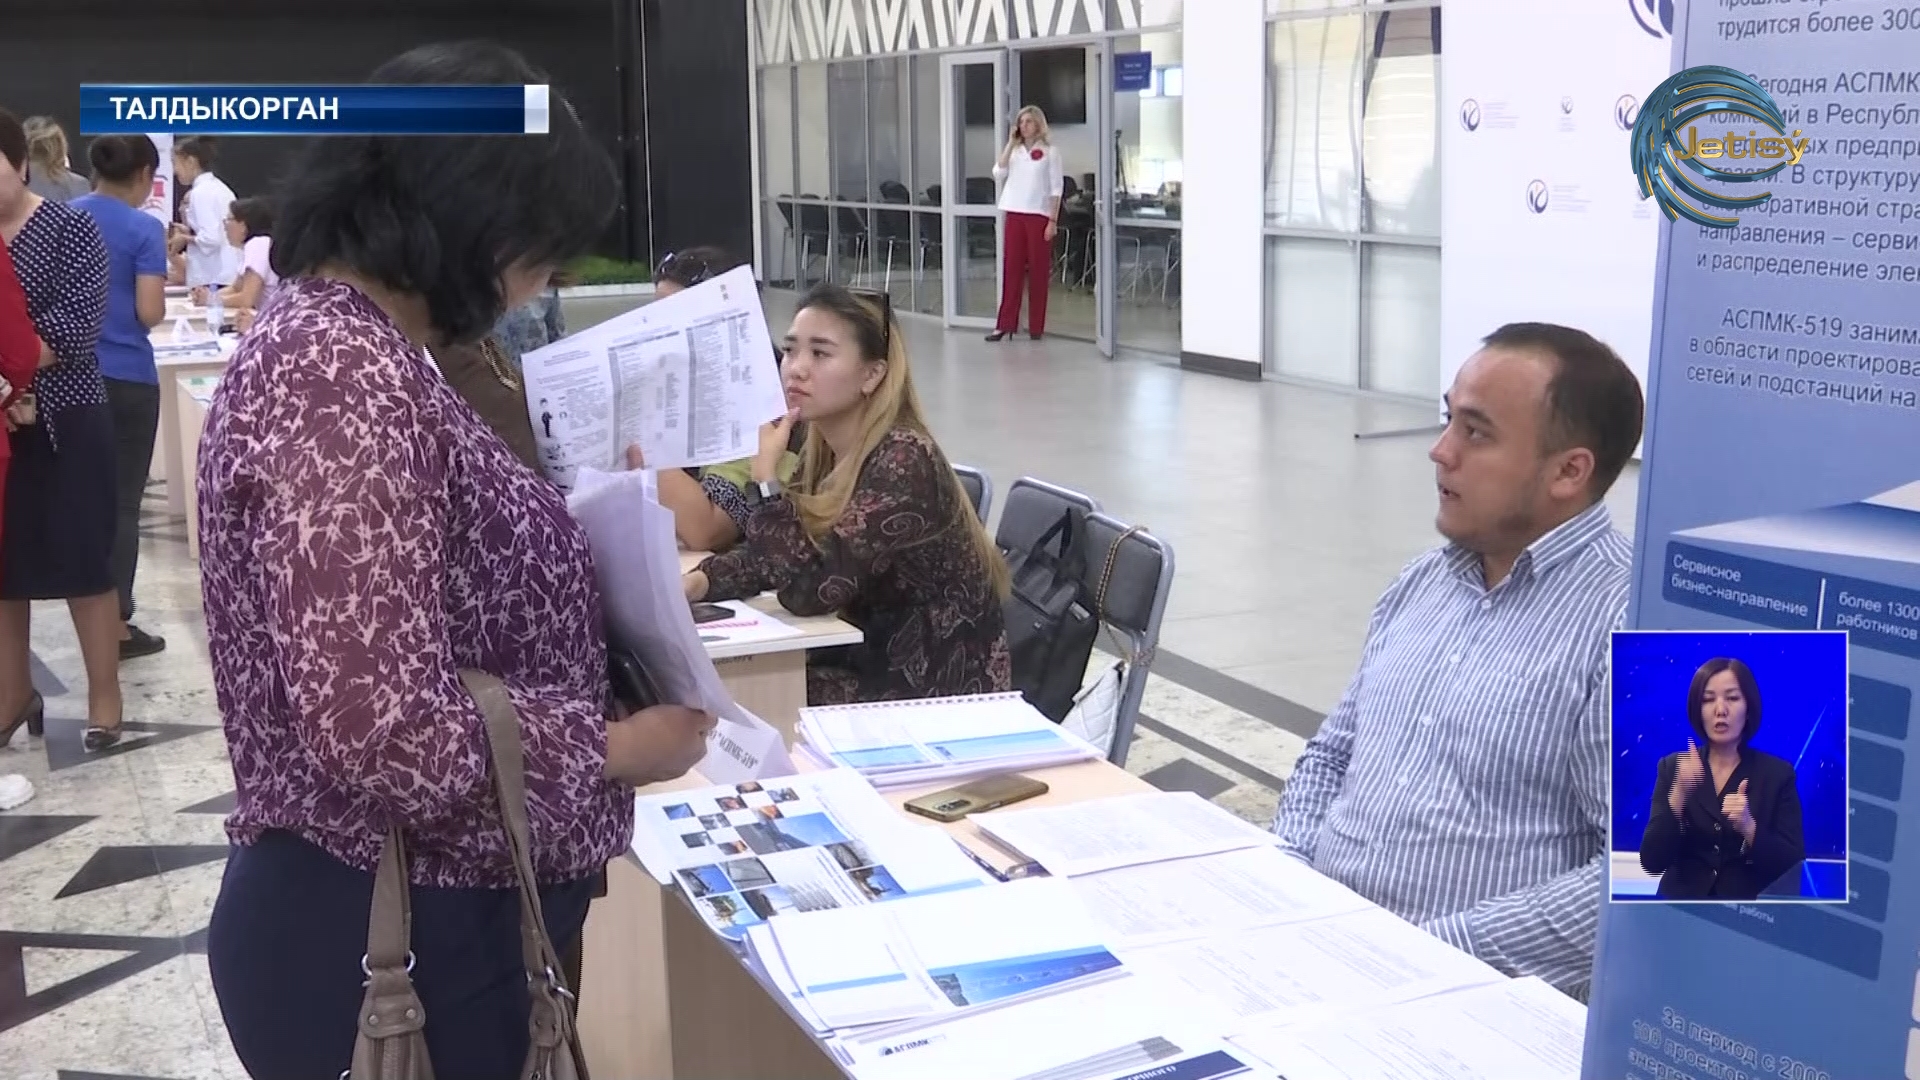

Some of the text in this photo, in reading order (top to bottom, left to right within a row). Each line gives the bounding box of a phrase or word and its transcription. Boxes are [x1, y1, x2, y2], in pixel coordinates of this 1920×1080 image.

[1718, 17, 1800, 41] трудится
[1807, 11, 1874, 33] более
[1807, 108, 1818, 124] в
[1791, 163, 1805, 185] В
[1813, 169, 1920, 193] структуру
[1699, 223, 1825, 246] направления
[1851, 231, 1920, 253] серви
[1696, 252, 1707, 267] и
[1711, 253, 1869, 279] распределение
[1721, 308, 1920, 345] АСПМК-519 заним
[1689, 335, 1920, 377] в области проектирова
[1686, 364, 1916, 408] сетей и подстанций на
[1672, 553, 1742, 583] Сервисное
[1671, 573, 1809, 618] бизнес-направление
[1838, 591, 1882, 613] более
[1836, 612, 1918, 640] работников
[1662, 1006, 1685, 1035] За
[1688, 1022, 1758, 1069] период
[1761, 1054, 1776, 1073] с
